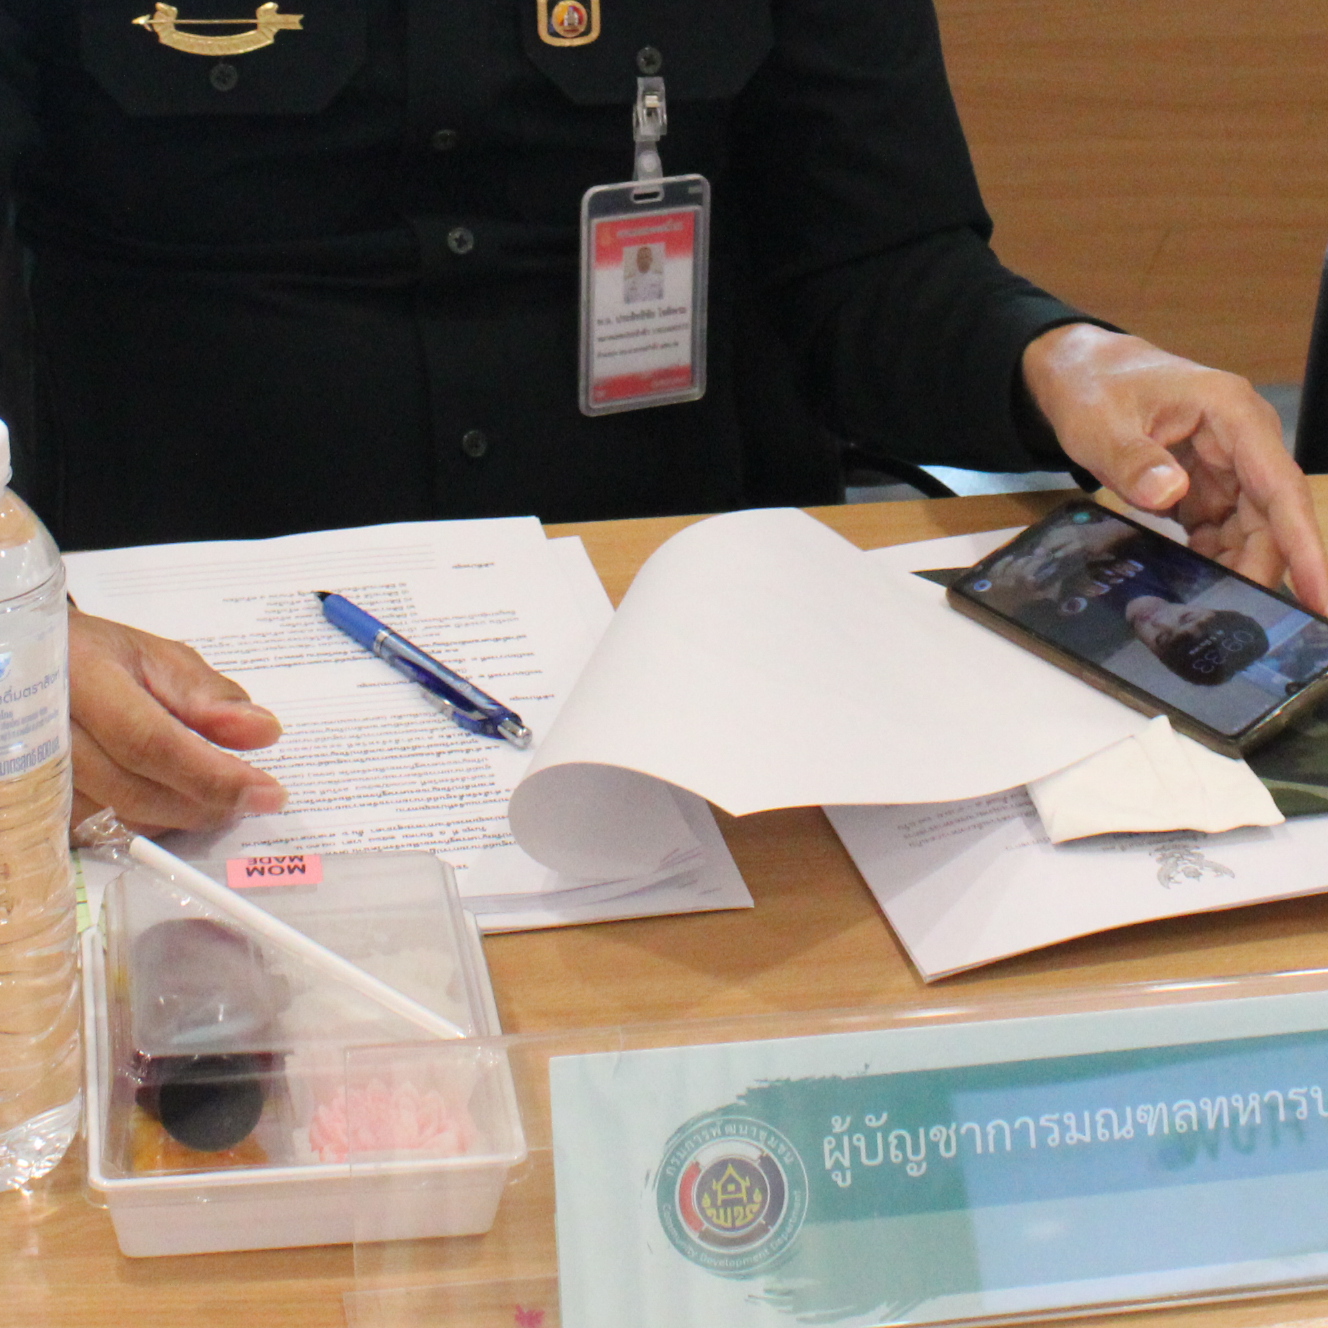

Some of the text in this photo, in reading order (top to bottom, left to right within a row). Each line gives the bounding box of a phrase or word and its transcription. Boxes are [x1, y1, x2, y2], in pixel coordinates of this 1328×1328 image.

[248, 855, 304, 866] MADE
[246, 863, 306, 878] MOM
[665, 1122, 795, 1176] กรมการพัฒนาชุมชน
